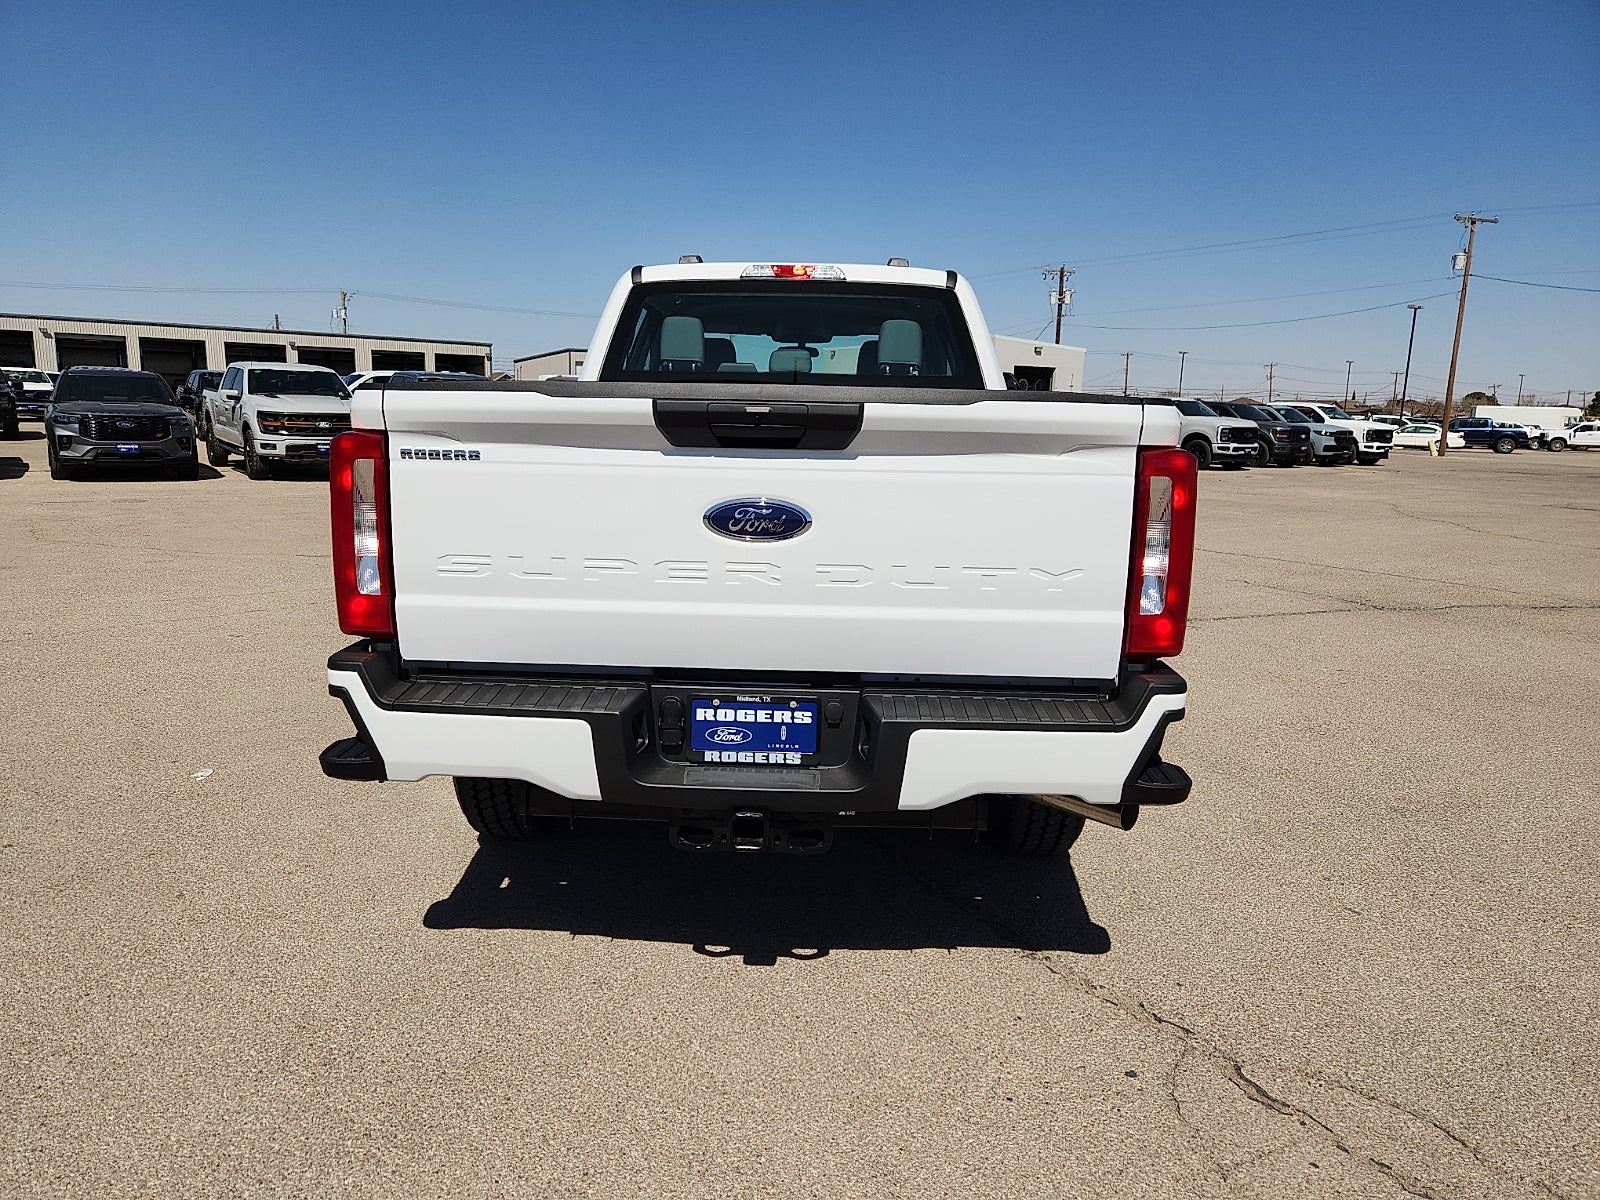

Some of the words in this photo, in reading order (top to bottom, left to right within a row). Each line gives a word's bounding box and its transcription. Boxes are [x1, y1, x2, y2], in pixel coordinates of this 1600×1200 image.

[728, 507, 787, 533] Ford
[436, 554, 782, 586] SUPER
[815, 563, 1085, 592] DUTY
[695, 708, 813, 724] ROGERS
[713, 729, 744, 742] Ford
[704, 750, 802, 765] ROGERS
